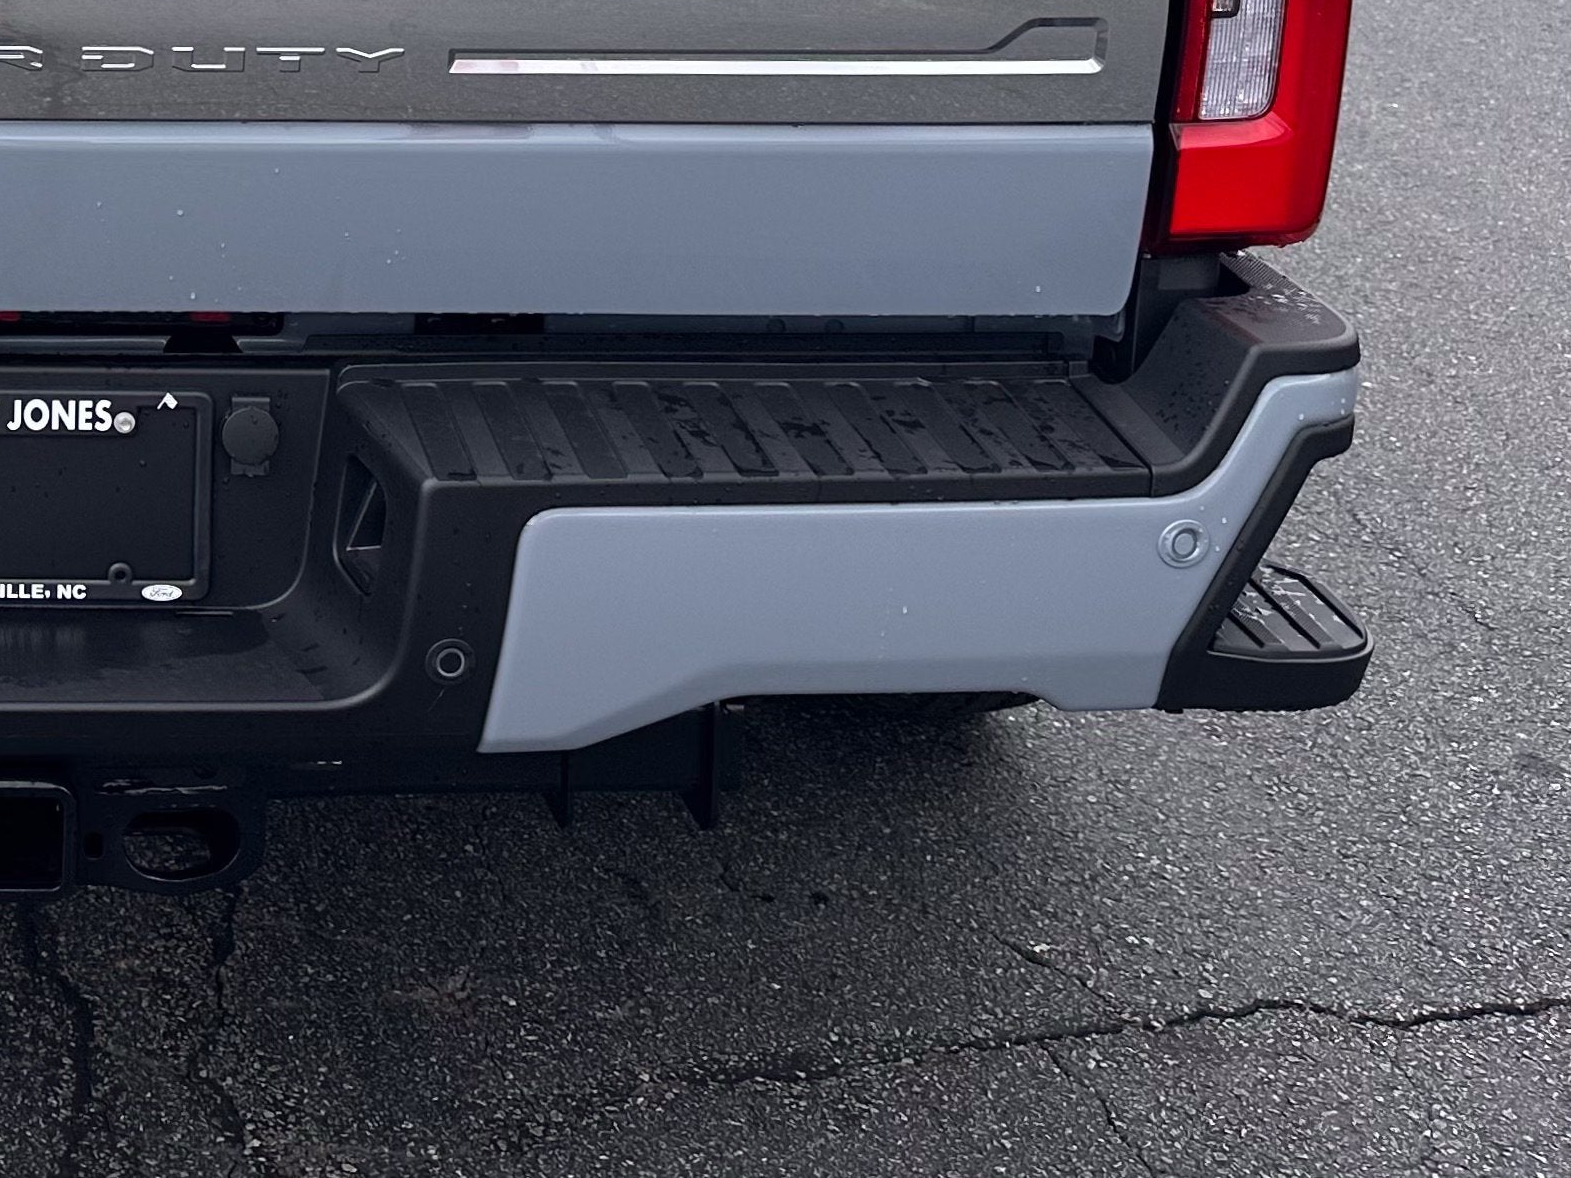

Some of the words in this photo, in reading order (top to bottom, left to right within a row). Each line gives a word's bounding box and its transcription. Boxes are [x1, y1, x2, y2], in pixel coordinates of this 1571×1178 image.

[81, 46, 406, 73] DUTY
[6, 399, 113, 432] JONES
[56, 585, 87, 600] NC
